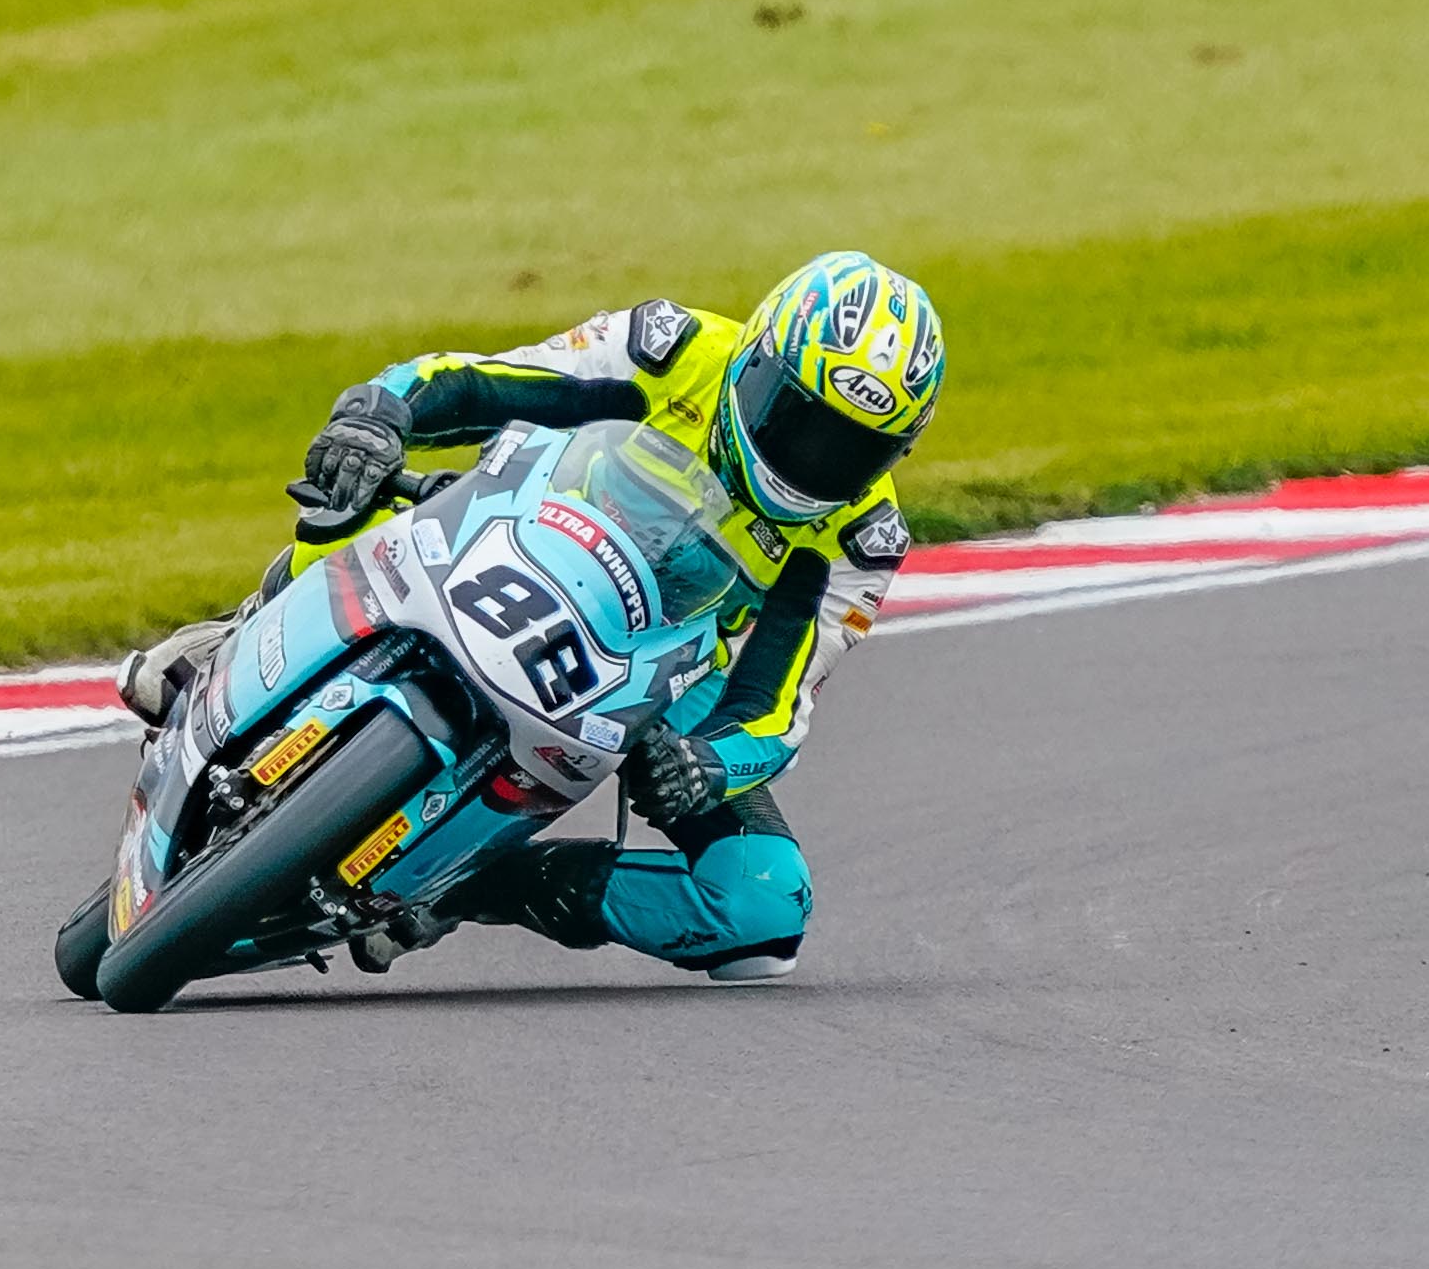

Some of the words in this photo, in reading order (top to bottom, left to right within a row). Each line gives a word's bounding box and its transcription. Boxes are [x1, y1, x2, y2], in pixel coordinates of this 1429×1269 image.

[833, 373, 893, 409] Arai
[539, 504, 596, 543] ULTRA
[448, 564, 600, 714] 88
[257, 723, 321, 782] PIRELLI
[345, 816, 410, 878] PIRELLI
